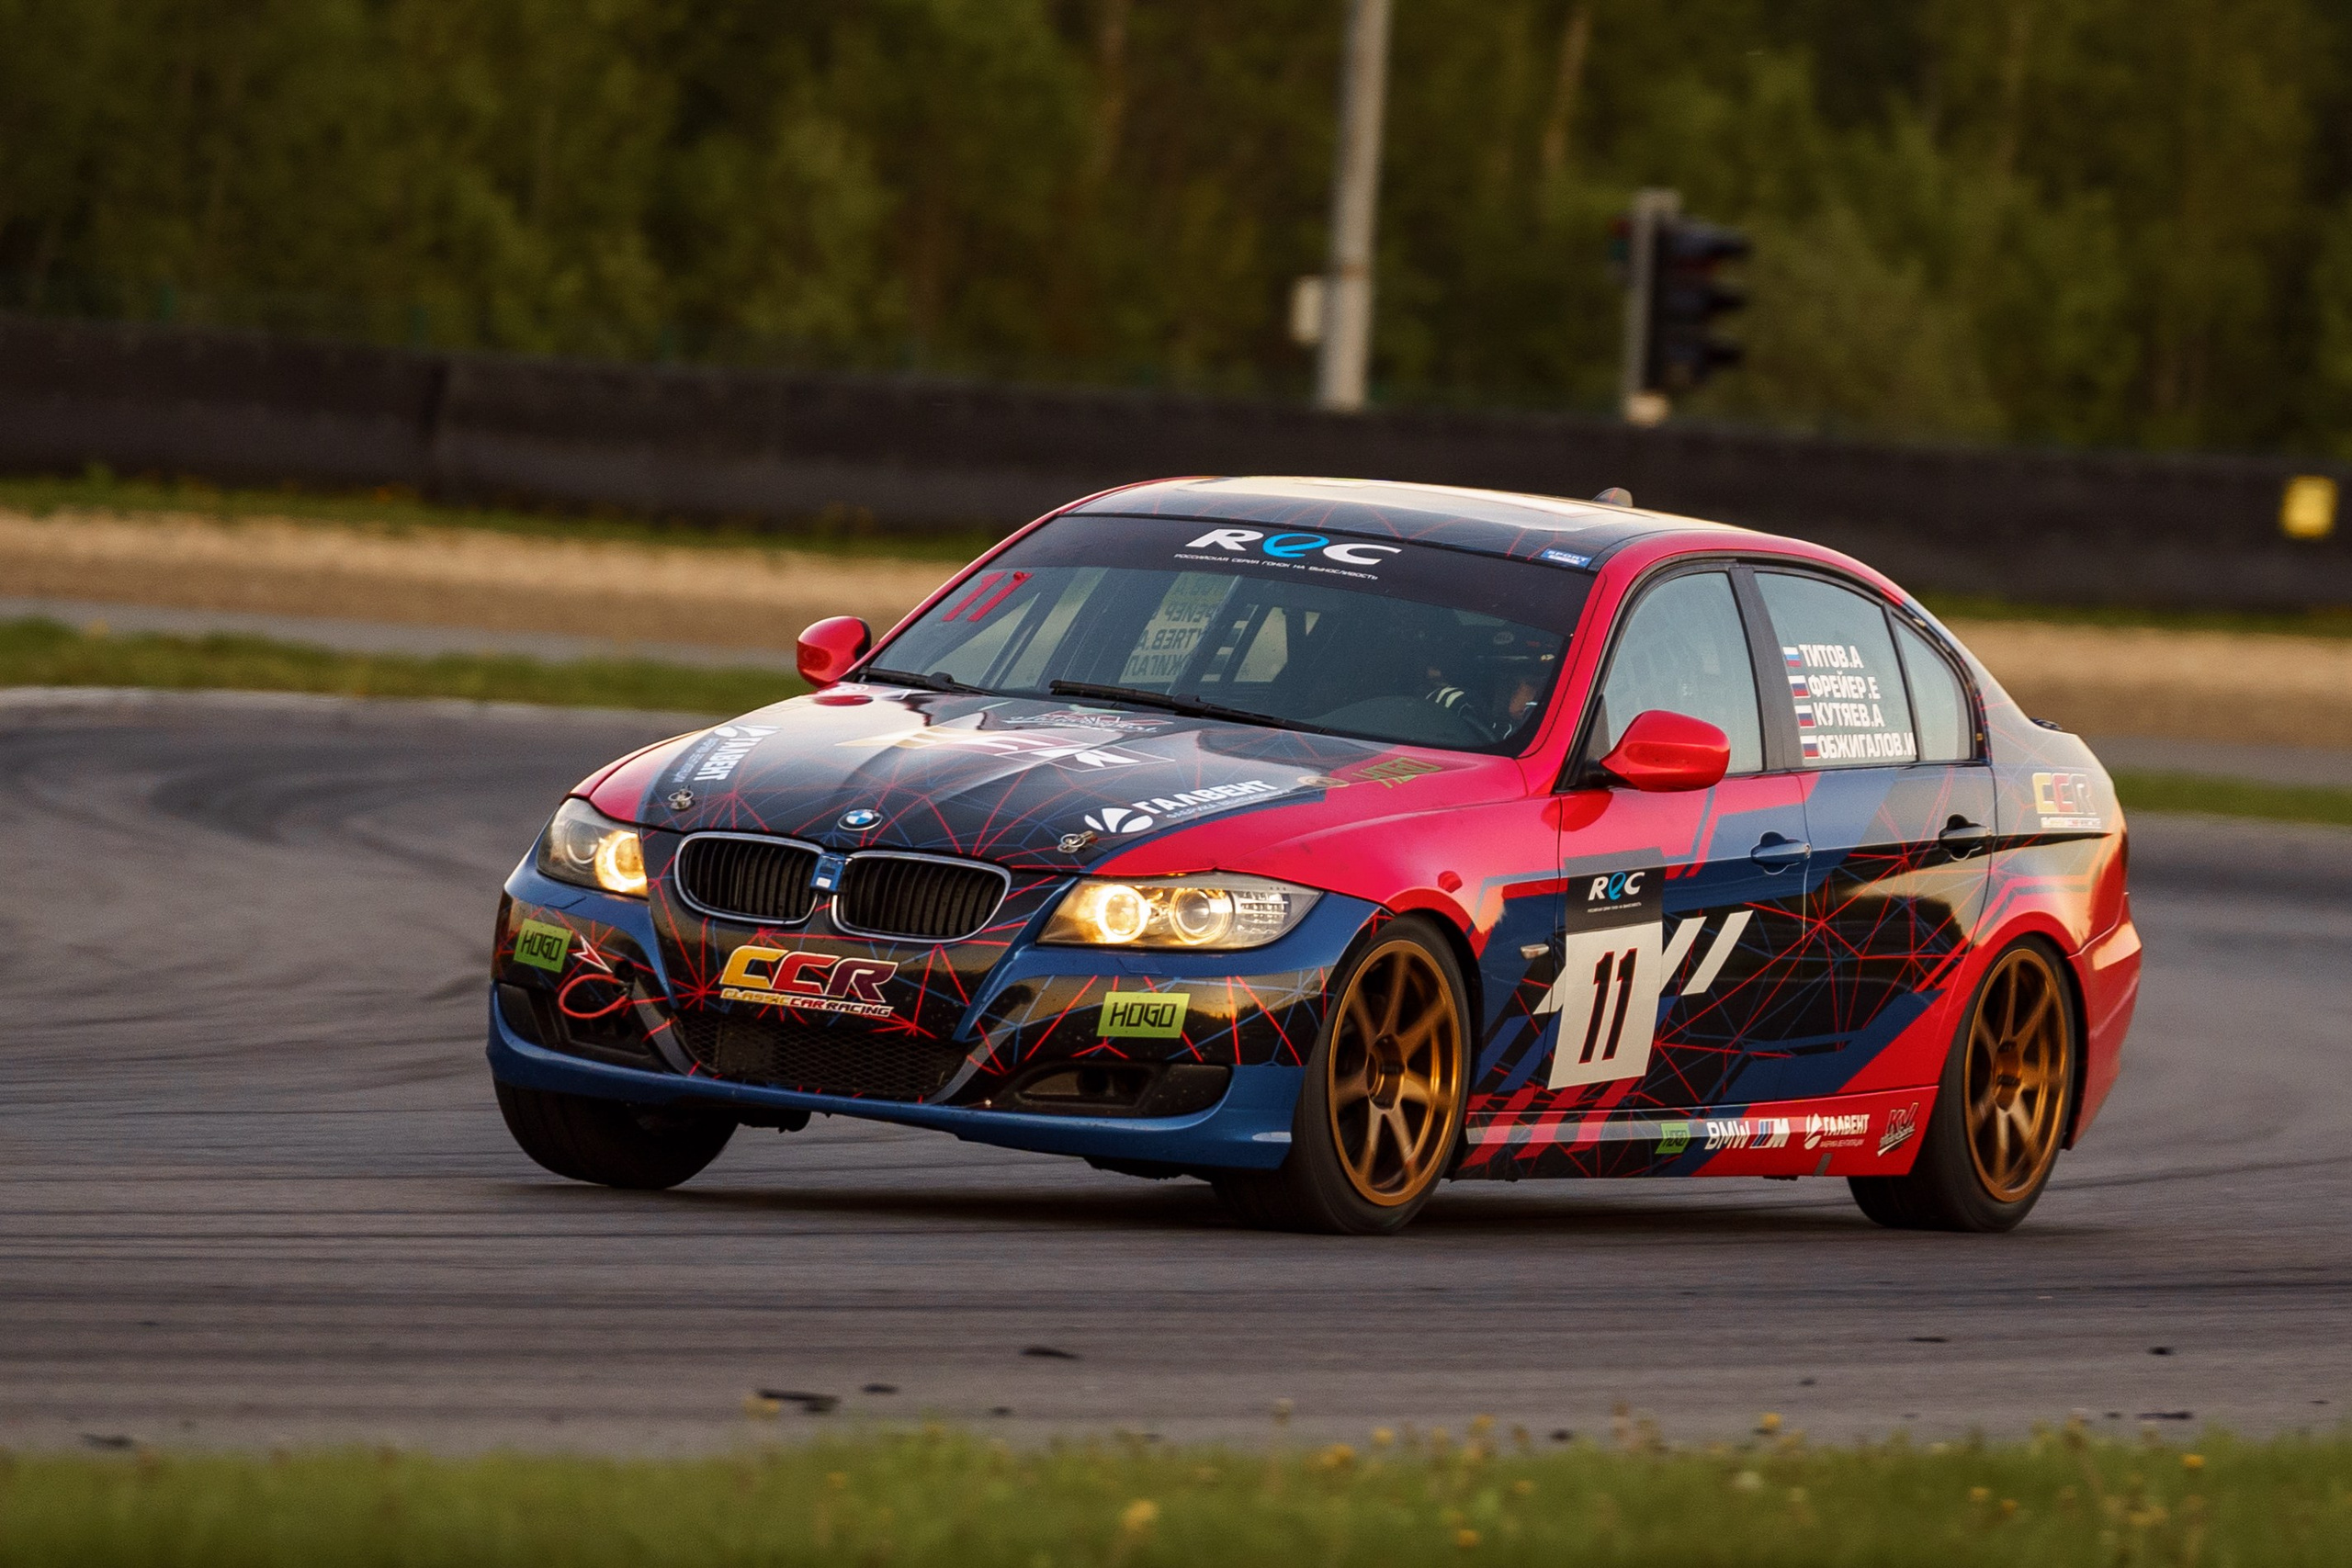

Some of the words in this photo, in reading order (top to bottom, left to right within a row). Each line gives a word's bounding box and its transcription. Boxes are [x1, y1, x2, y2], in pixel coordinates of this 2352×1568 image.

[1173, 553, 1229, 562] РОССИЙСКАЯ
[1308, 567, 1378, 581] ВЫНОСЛИВОСТЬ
[942, 571, 1034, 622] 11
[1799, 644, 1864, 669] ТИТОВ.А
[1807, 671, 1882, 699] ФРЕЙЕР.Е
[1813, 703, 1885, 728] КУТЯЕВ.А
[1818, 732, 1917, 759] ОБЖИГАЛОВ.И
[522, 929, 563, 962] HOGO
[719, 945, 899, 1003] CCR
[1108, 1002, 1178, 1028] HOGO
[1578, 947, 1638, 1065] 11
[1704, 1121, 1750, 1149] BMW
